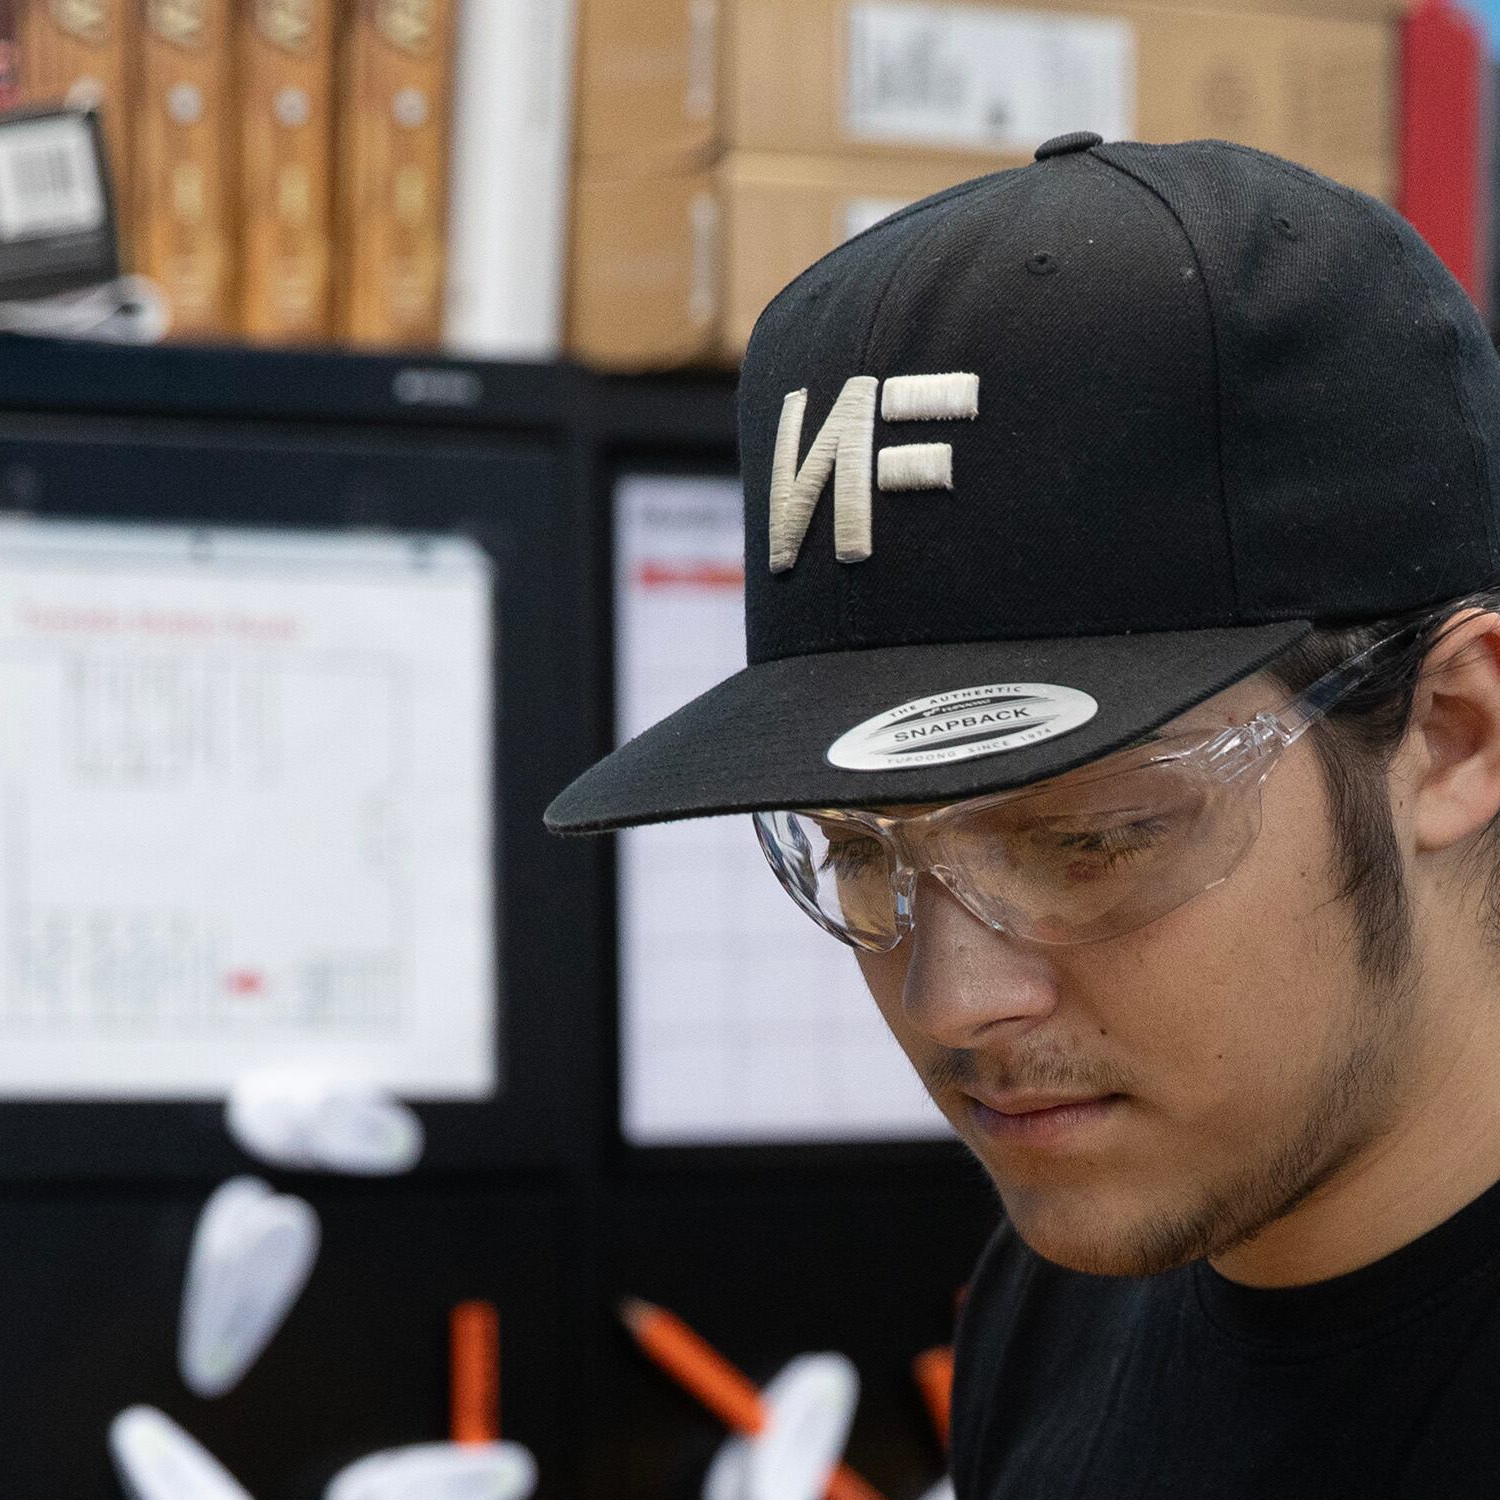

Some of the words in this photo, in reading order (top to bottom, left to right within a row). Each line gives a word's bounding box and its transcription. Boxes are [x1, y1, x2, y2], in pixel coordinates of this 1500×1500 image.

[890, 704, 916, 718] THE
[929, 685, 1022, 705] AUTHENTIC
[893, 707, 1031, 743] SNAPBACK
[886, 750, 957, 764] YUPOONG
[968, 740, 1008, 752] SINCE
